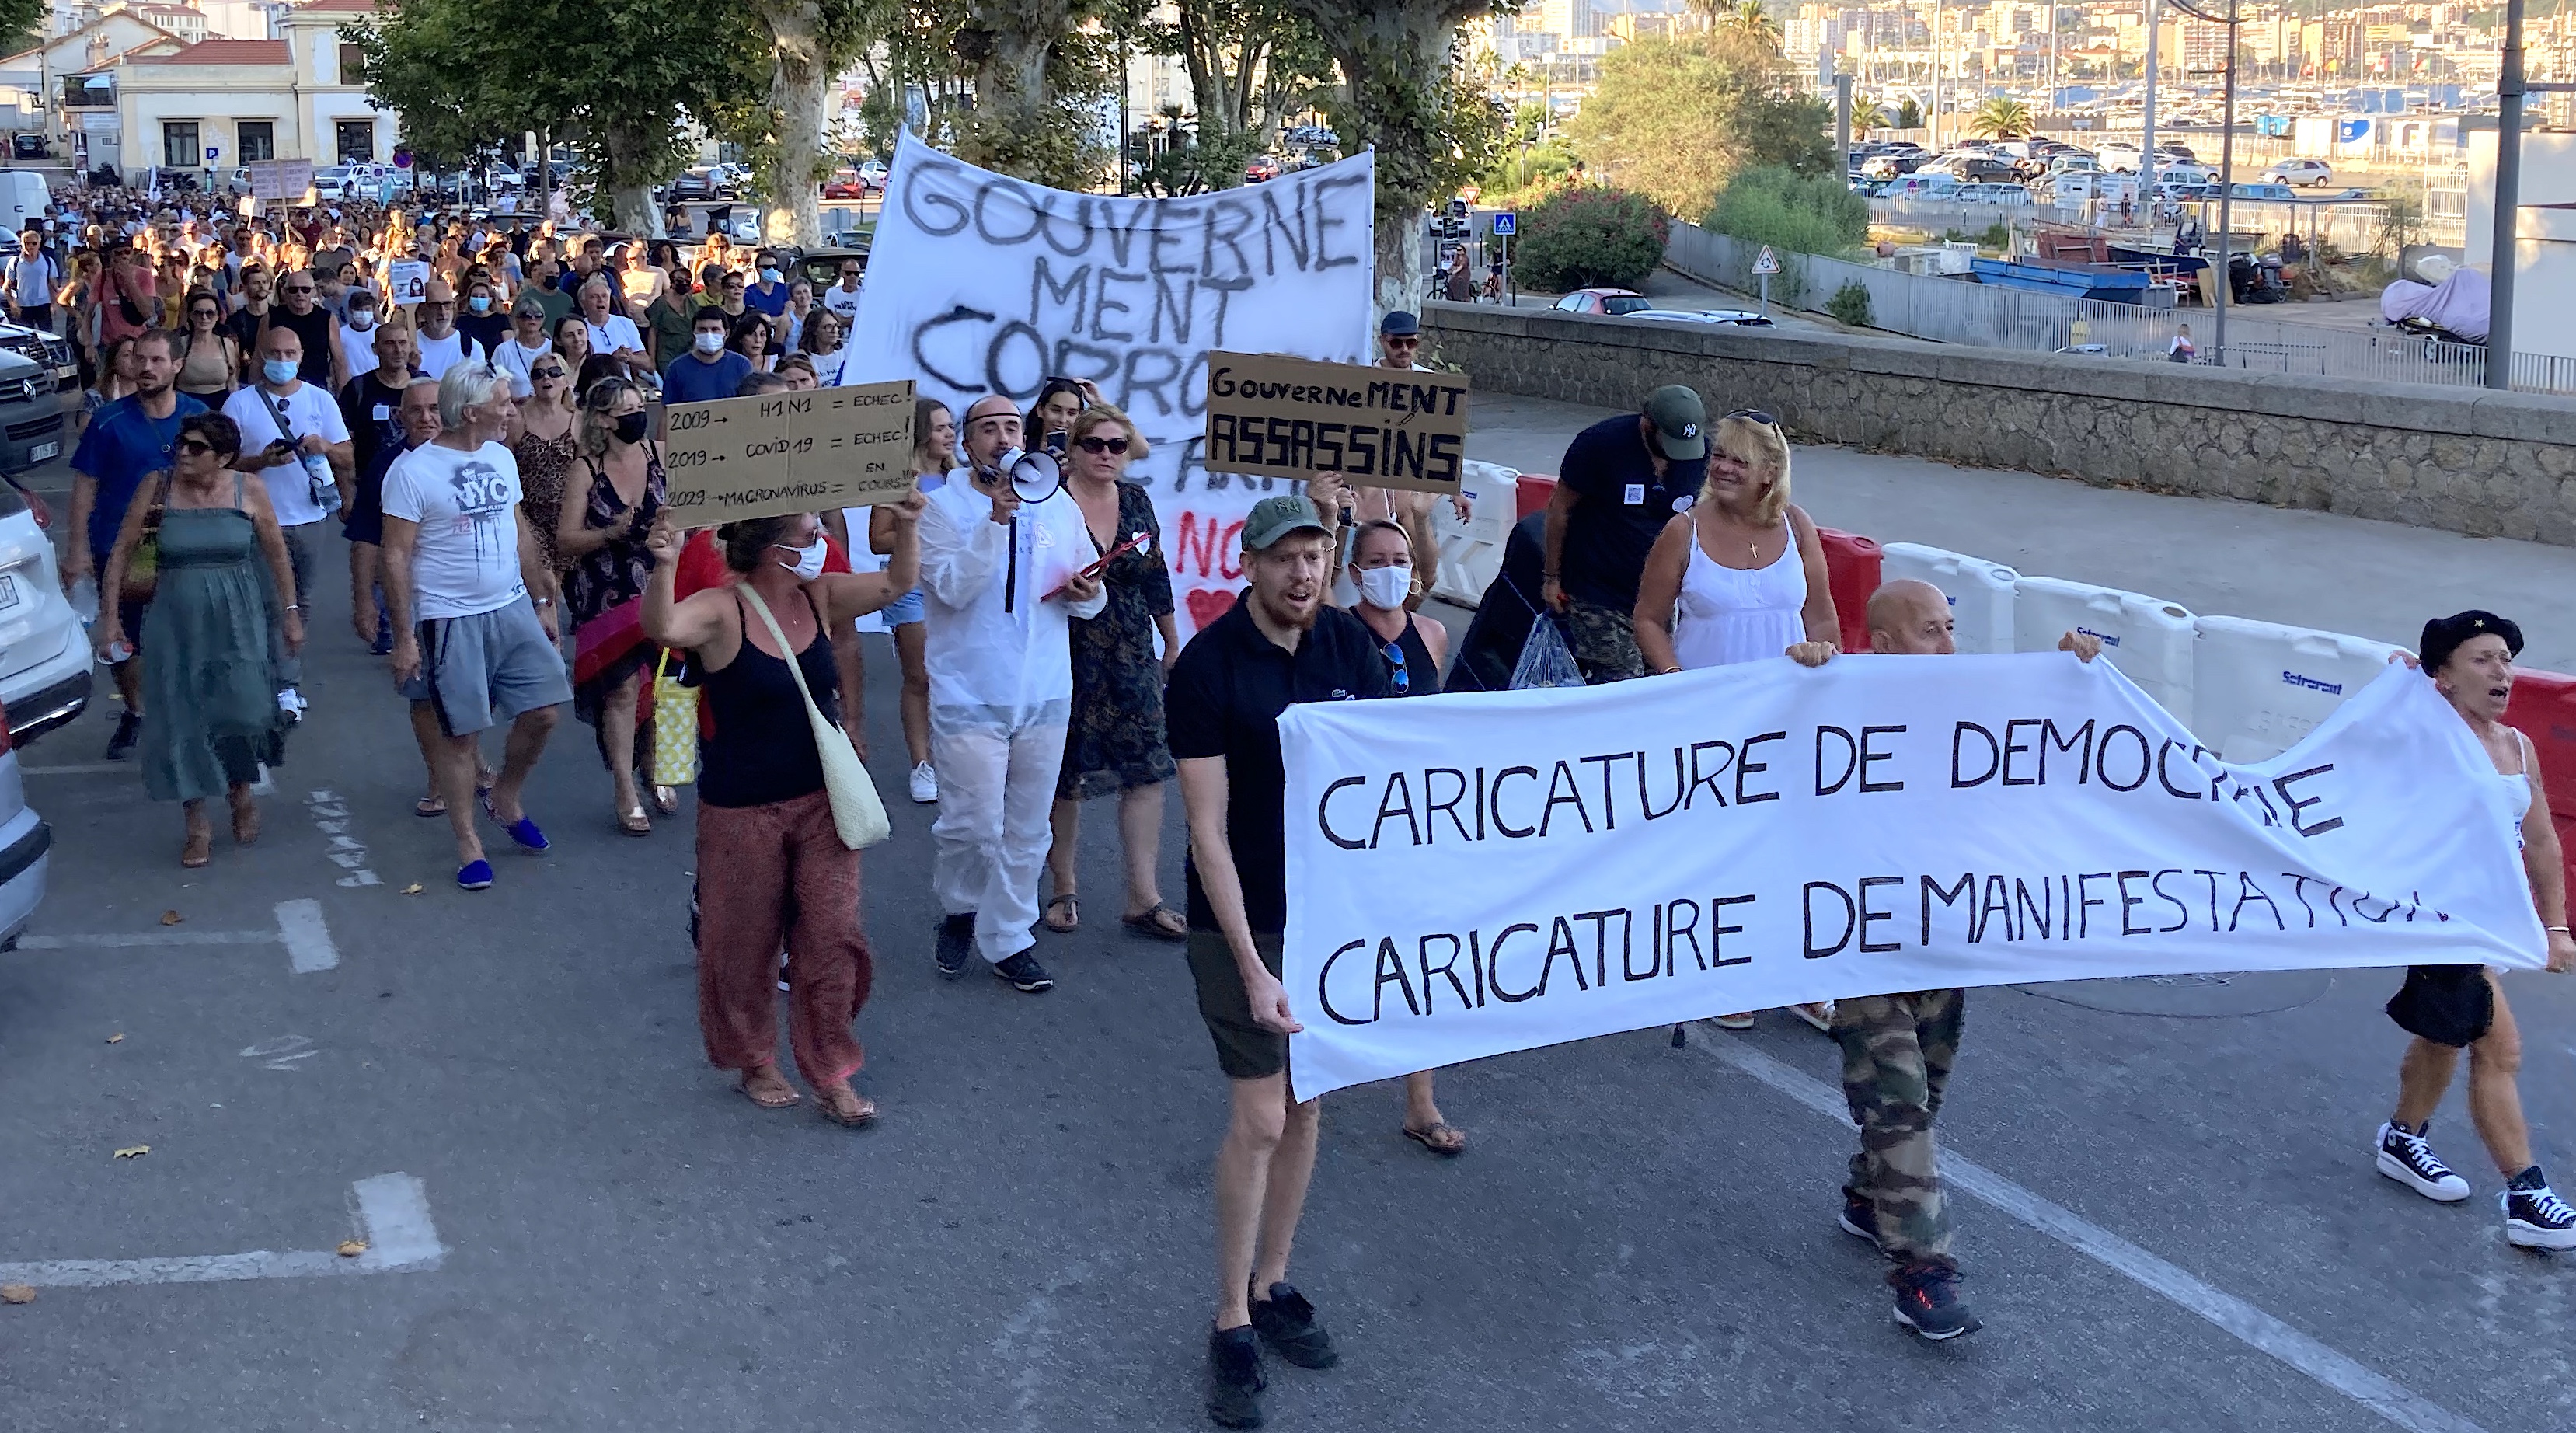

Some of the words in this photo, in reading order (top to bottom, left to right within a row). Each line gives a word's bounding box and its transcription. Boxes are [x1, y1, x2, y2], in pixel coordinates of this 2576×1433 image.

[903, 159, 1366, 277] GOUVERNE
[1030, 256, 1254, 347] MENT
[669, 410, 710, 431] 2009
[761, 398, 812, 418] H1N1
[1682, 423, 1696, 438] NY
[669, 451, 707, 469] 2019
[793, 438, 813, 454] 19
[866, 462, 885, 472] EN
[451, 477, 511, 507] NYC
[669, 490, 706, 507] 2029
[1319, 730, 1786, 849] CARICATURE
[1814, 725, 1907, 796] DE
[1319, 894, 1756, 1025] CARICATURE
[1803, 877, 1904, 958] DE
